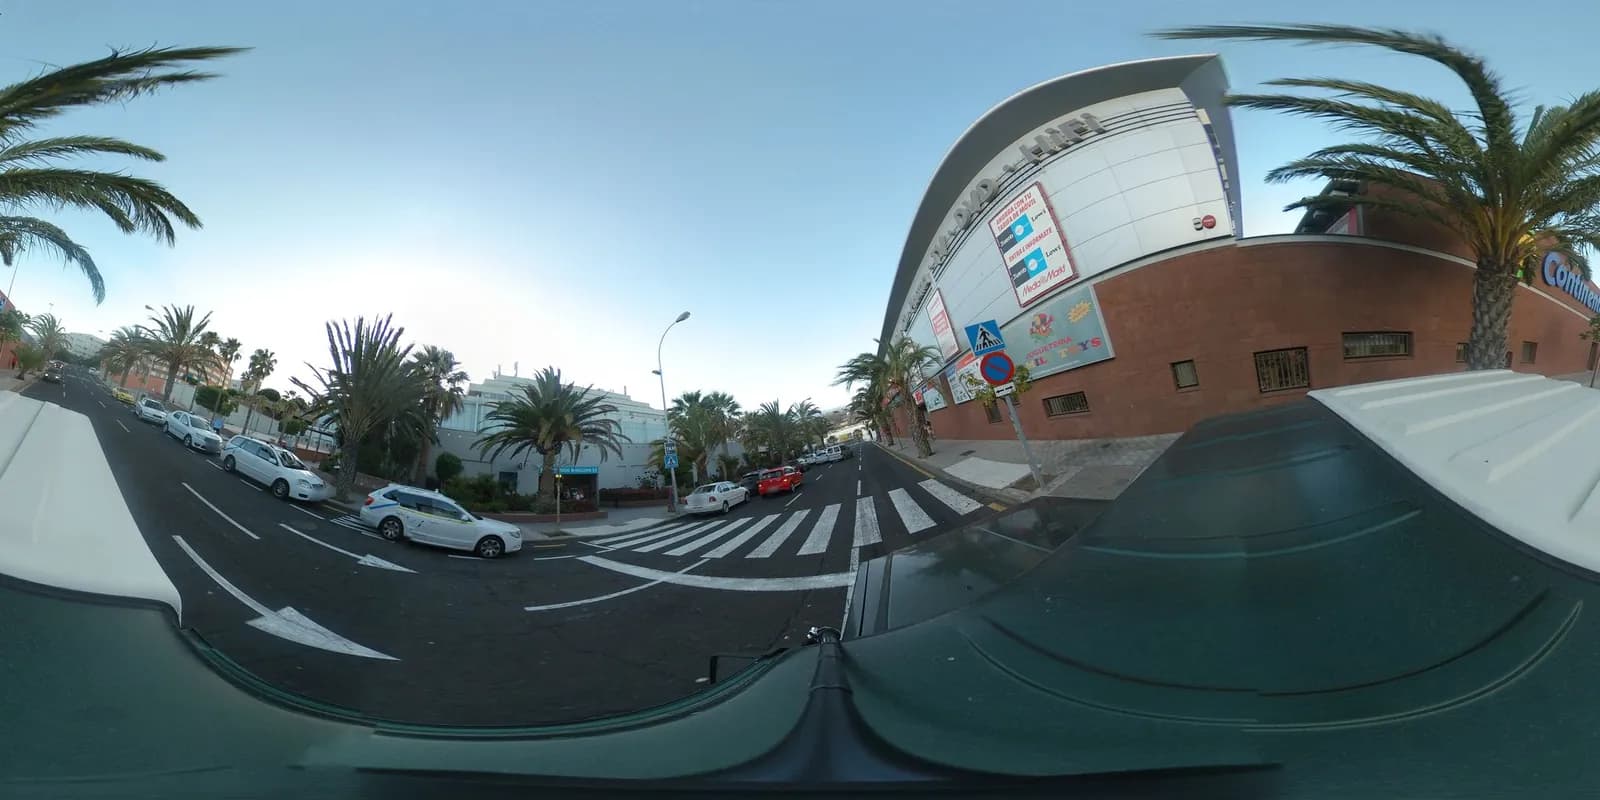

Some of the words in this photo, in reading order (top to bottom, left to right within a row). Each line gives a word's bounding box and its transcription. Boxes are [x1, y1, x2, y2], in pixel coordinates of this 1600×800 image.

[953, 178, 998, 231] DVD
[1019, 112, 1106, 164] HiFi
[1014, 198, 1025, 211] CON
[1024, 192, 1032, 202] TU
[1058, 336, 1102, 359] TOYS
